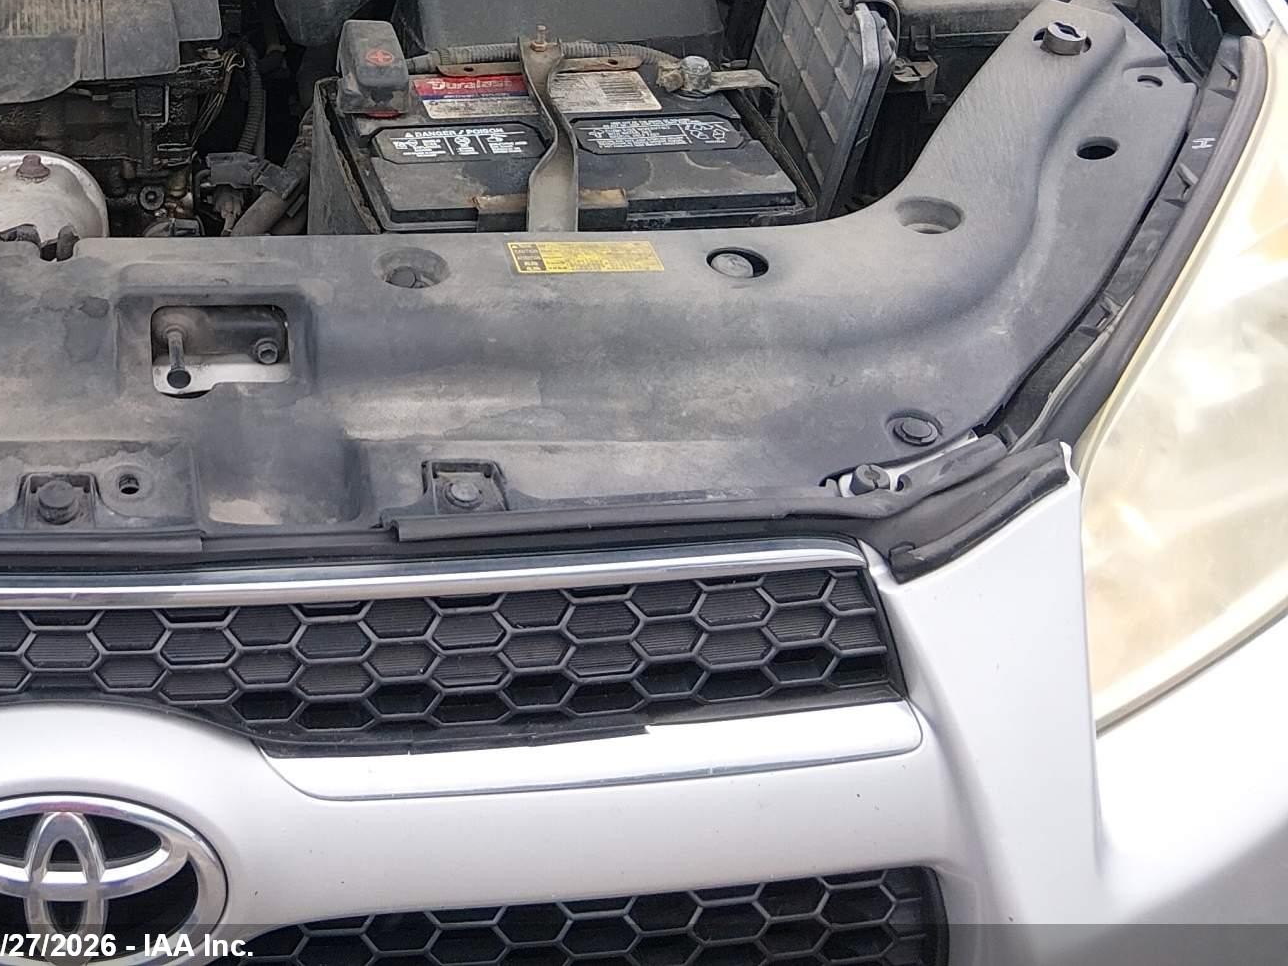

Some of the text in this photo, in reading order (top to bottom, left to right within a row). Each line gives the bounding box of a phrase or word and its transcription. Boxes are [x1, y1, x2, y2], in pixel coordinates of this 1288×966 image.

[426, 79, 513, 90] Duralast
[414, 129, 457, 138] DANGER
[465, 127, 505, 135] POISON
